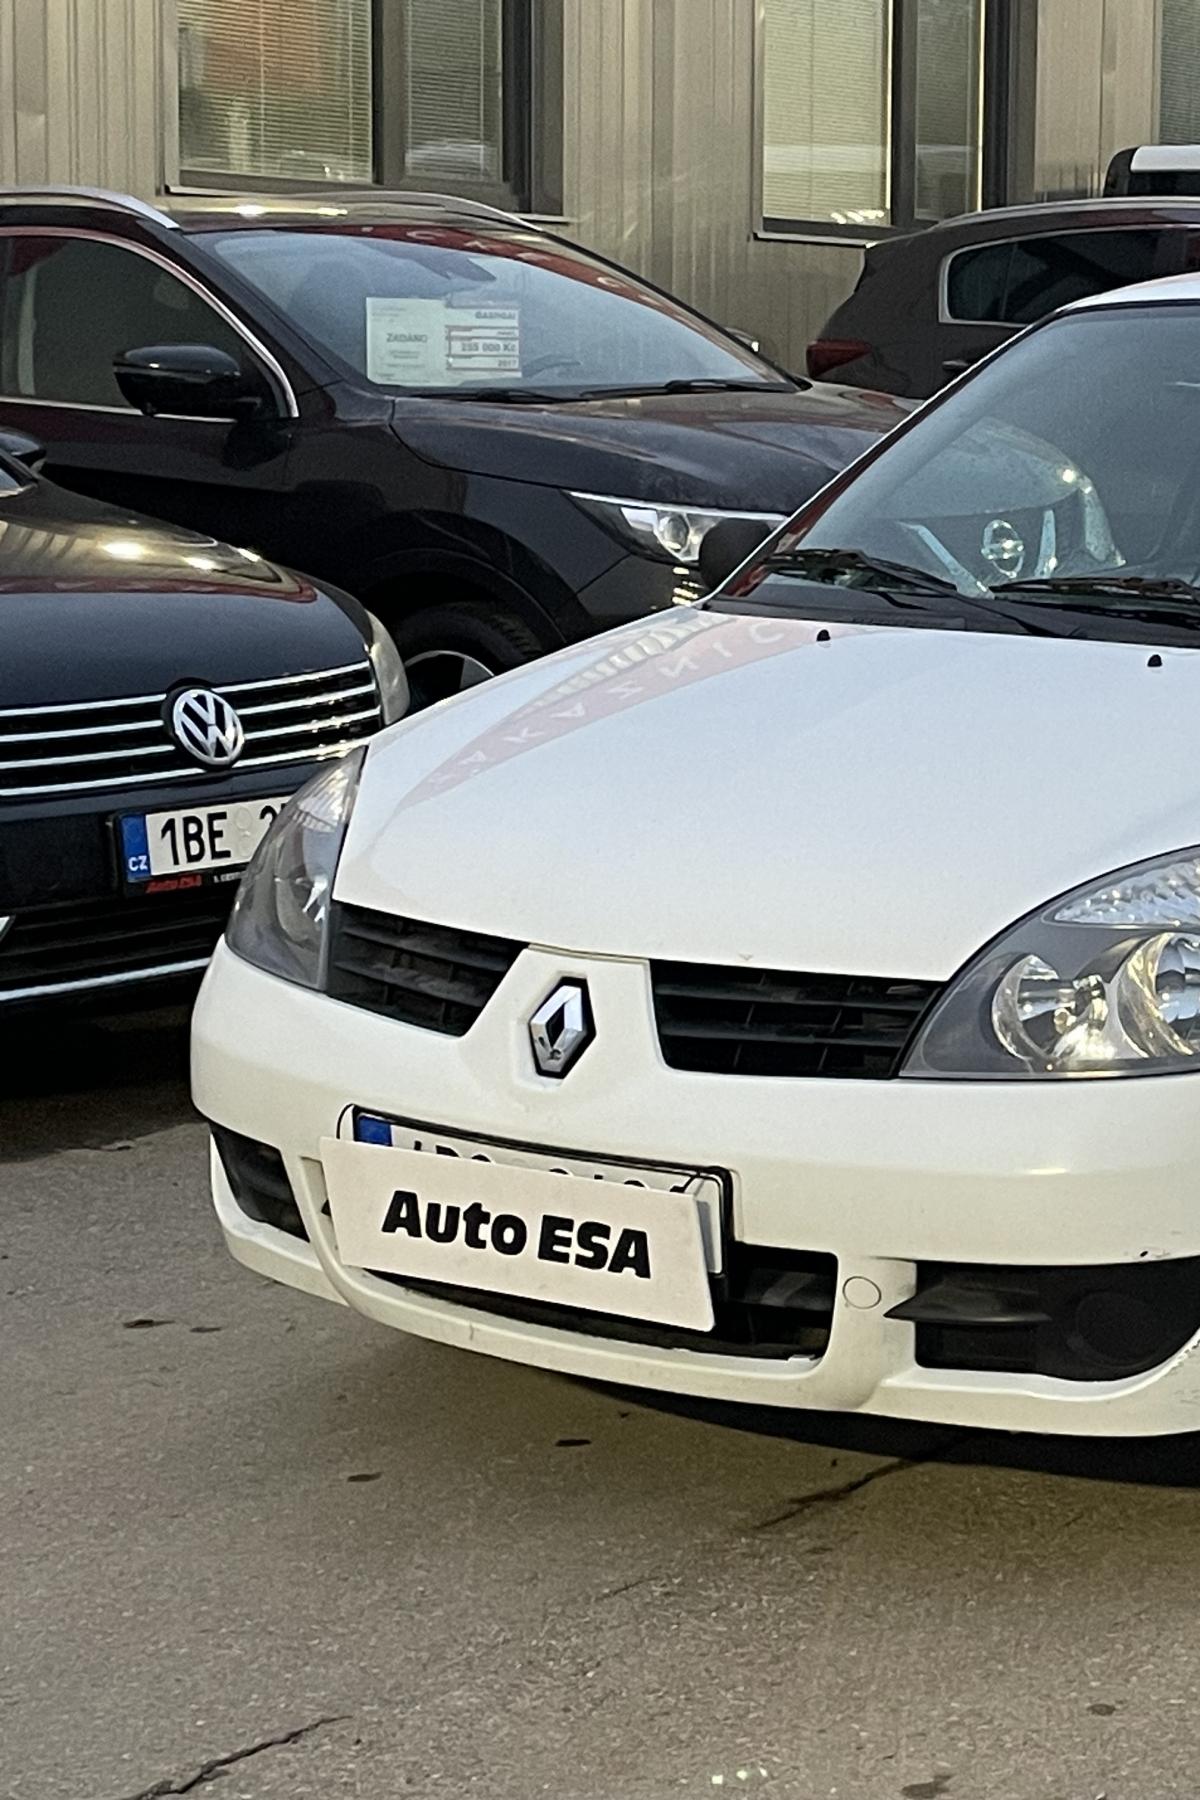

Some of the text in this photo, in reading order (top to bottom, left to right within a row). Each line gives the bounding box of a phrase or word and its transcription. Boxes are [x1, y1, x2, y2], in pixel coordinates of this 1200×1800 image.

[129, 855, 149, 872] CZ
[161, 811, 231, 866] 1BE
[381, 1190, 651, 1279] Auto ESA
